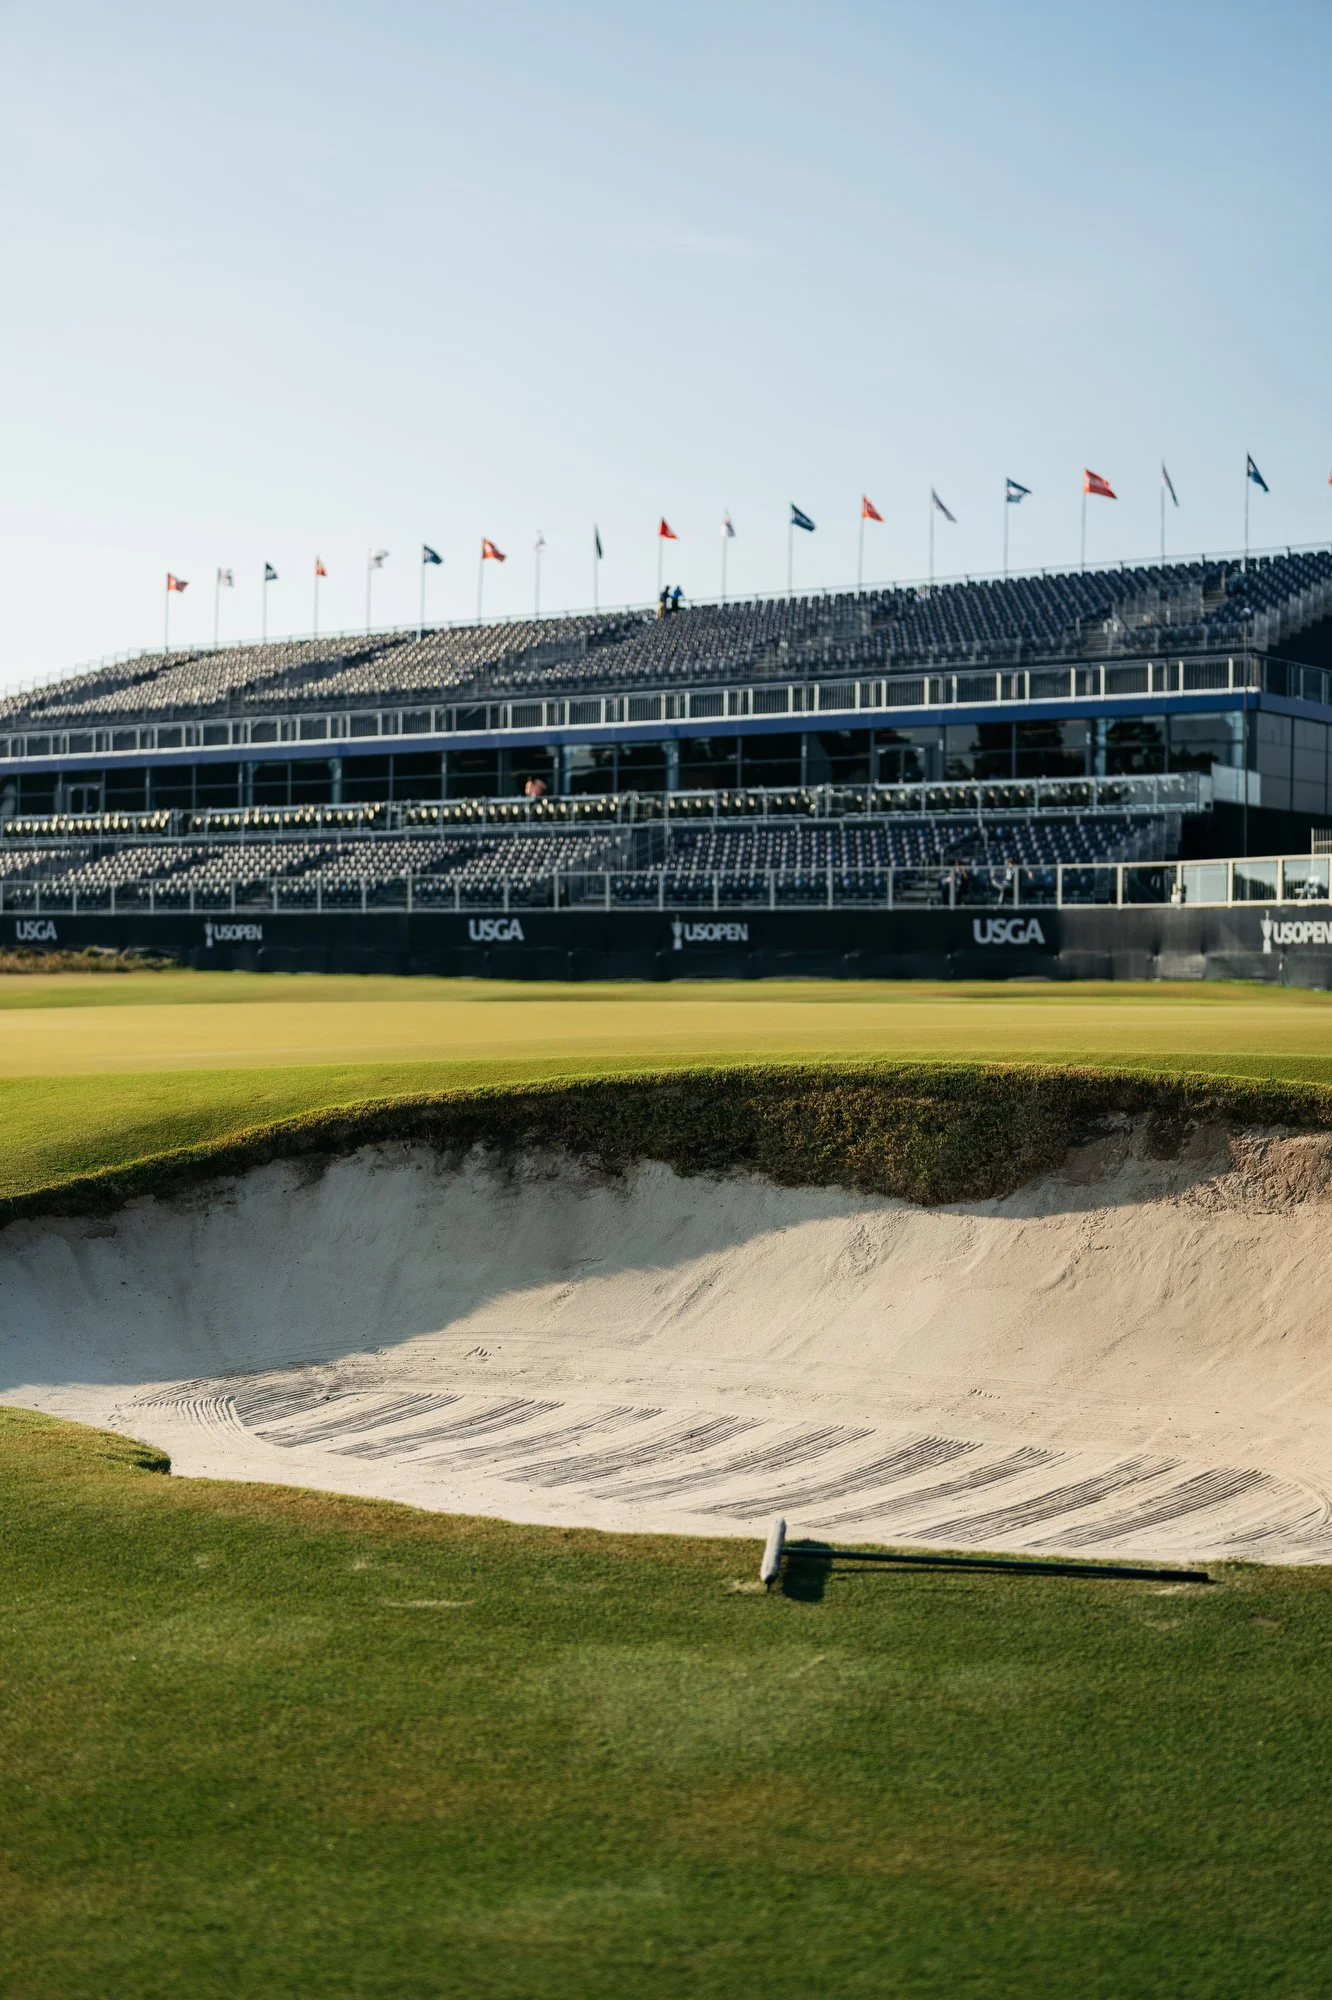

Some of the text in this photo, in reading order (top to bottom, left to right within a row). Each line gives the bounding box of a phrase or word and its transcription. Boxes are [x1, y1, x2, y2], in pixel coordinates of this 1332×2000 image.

[16, 920, 58, 940] USGA
[468, 919, 524, 941] USGA
[972, 918, 1046, 944] USGA
